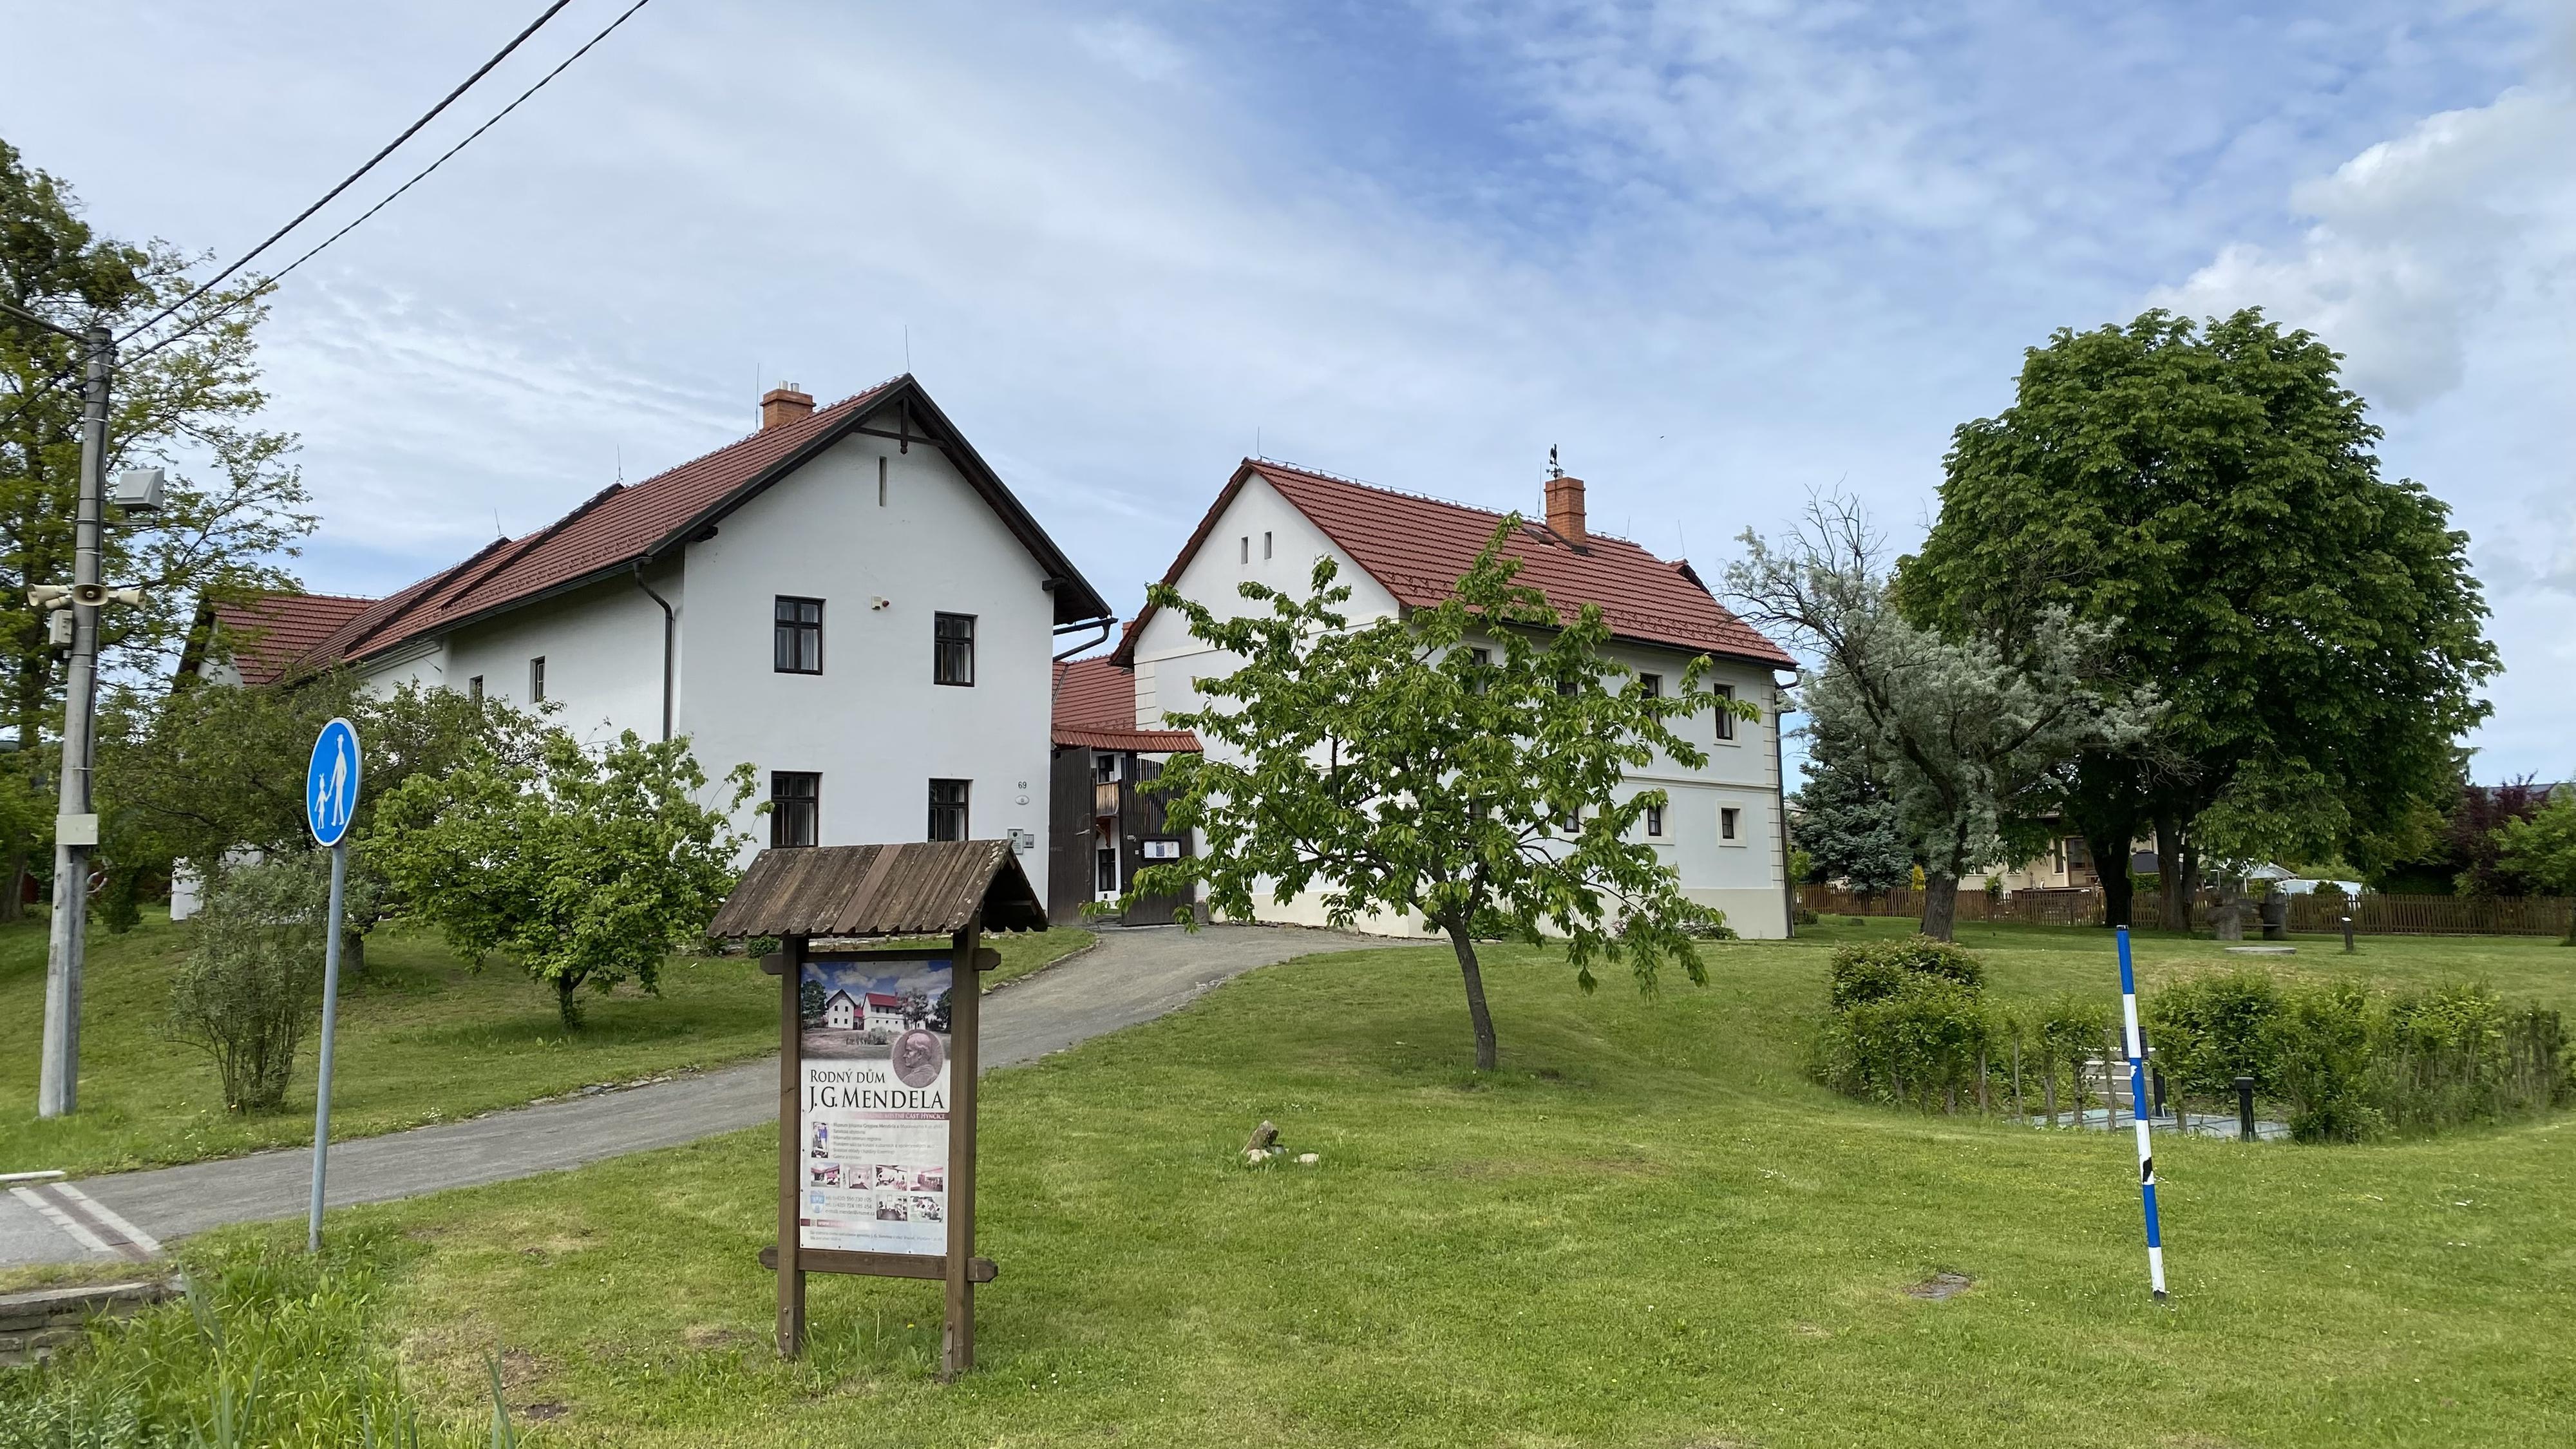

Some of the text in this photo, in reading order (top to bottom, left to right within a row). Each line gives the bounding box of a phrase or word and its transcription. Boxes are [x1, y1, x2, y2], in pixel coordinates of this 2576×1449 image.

[810, 1068, 886, 1083] RODNÝ DŮM
[842, 1086, 945, 1109] MENDELA
